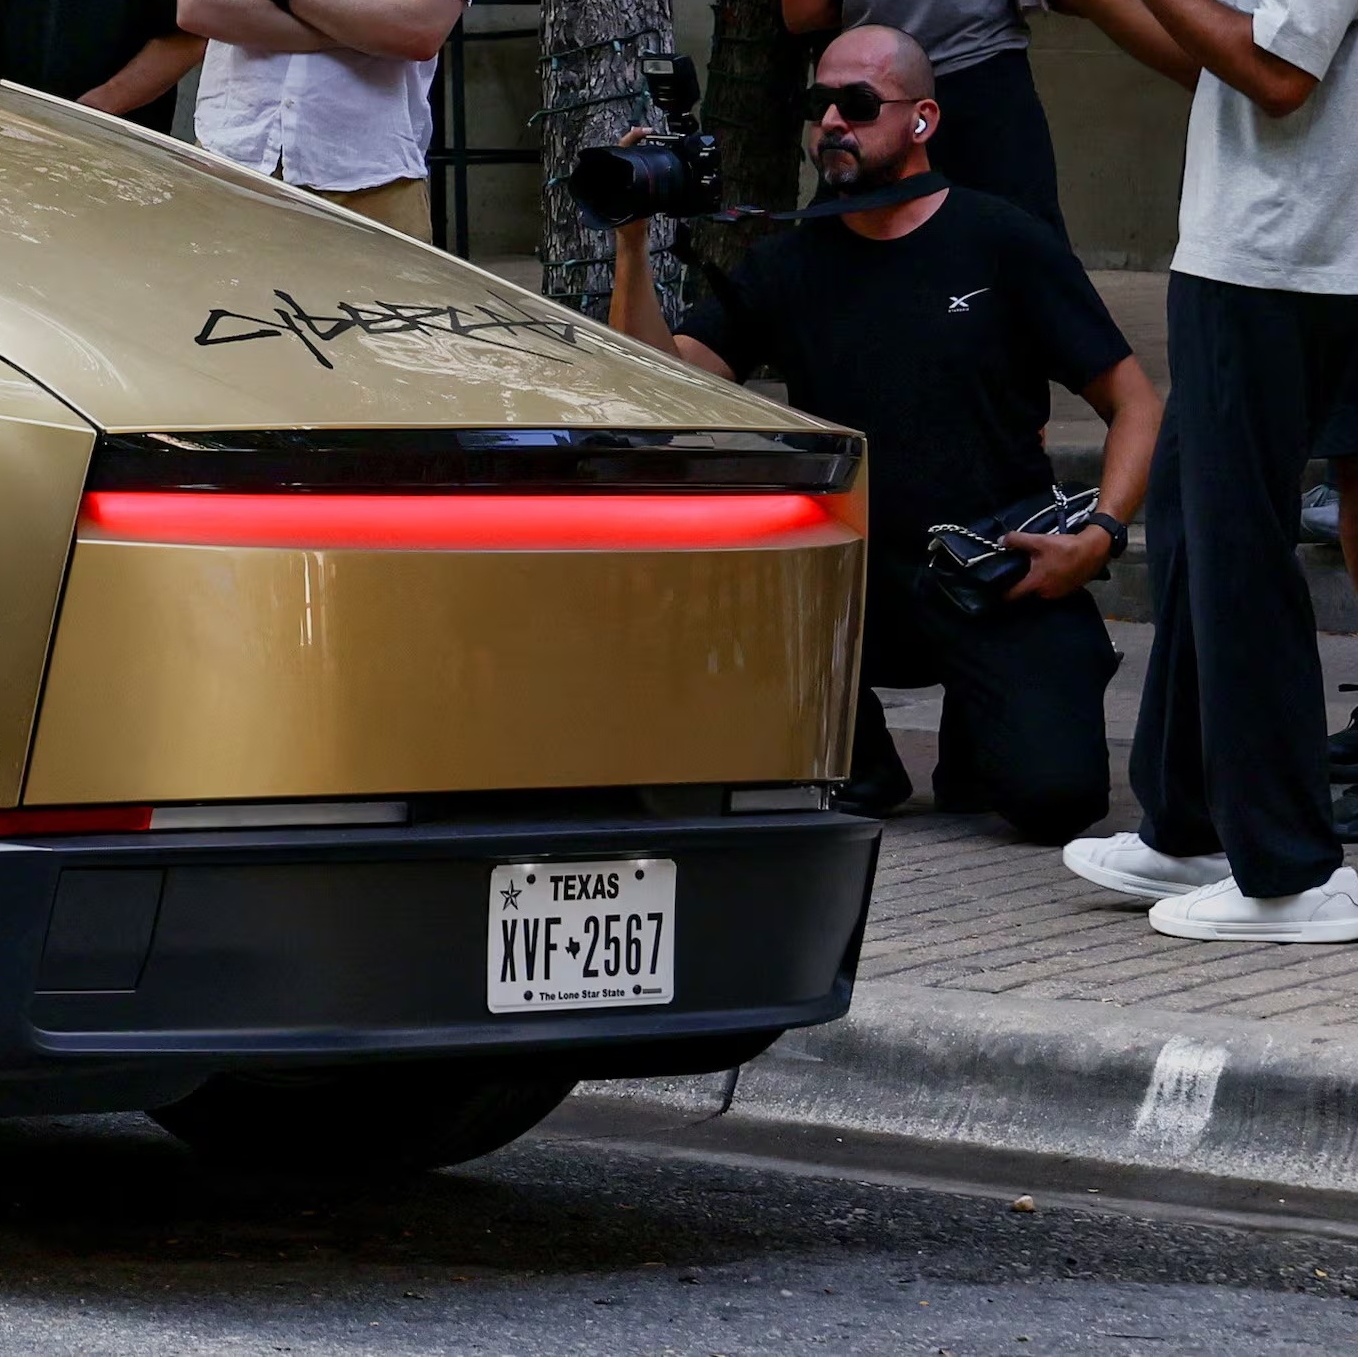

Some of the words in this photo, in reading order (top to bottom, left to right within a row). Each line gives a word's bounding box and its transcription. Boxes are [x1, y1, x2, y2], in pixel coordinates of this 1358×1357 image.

[550, 872, 619, 901] TEXAS
[500, 917, 562, 983] XVF
[582, 912, 664, 978] 2567
[539, 991, 555, 1001] The
[558, 989, 579, 1000] Lone
[582, 988, 600, 999] Star
[602, 987, 625, 998] State
